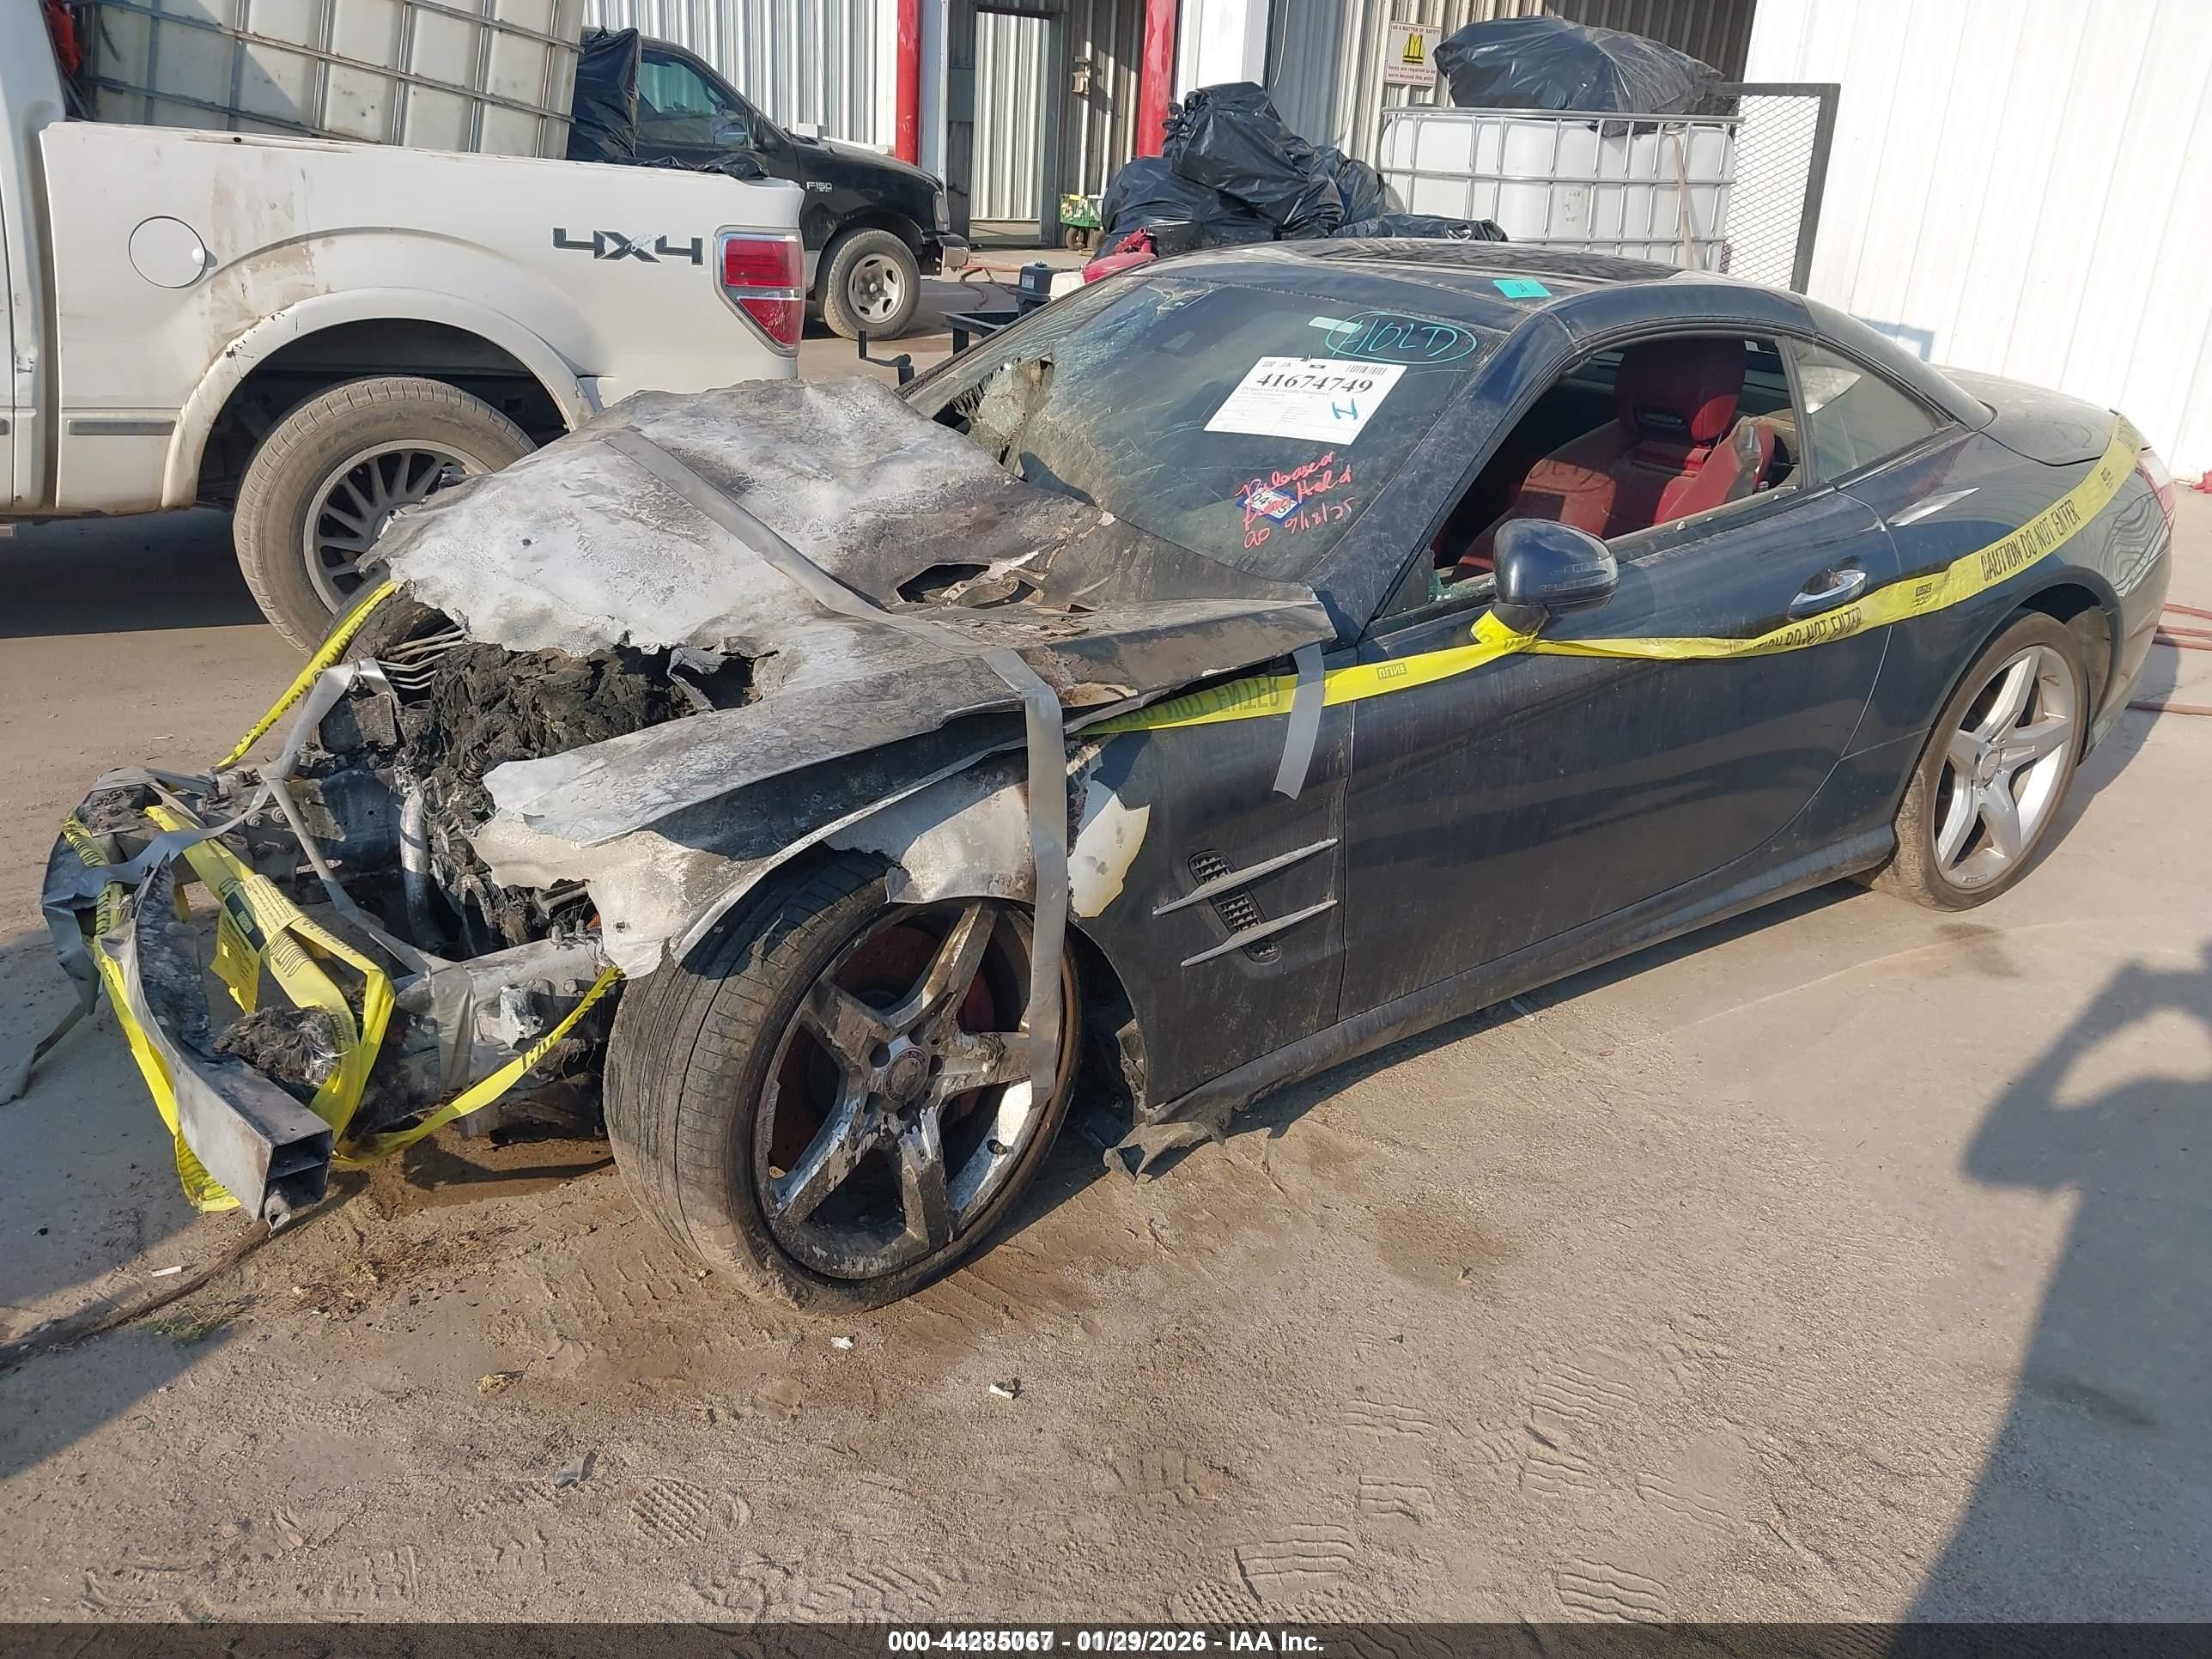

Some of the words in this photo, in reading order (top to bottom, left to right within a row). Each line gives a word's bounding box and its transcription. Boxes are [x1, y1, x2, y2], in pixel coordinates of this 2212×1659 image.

[1330, 319, 1460, 357] HOLD
[1256, 372, 1374, 394] 41674749
[1980, 537, 2024, 582] CAUTION
[2019, 530, 2037, 559] DO
[2033, 517, 2056, 550] NOT
[2051, 499, 2081, 537] ENTER
